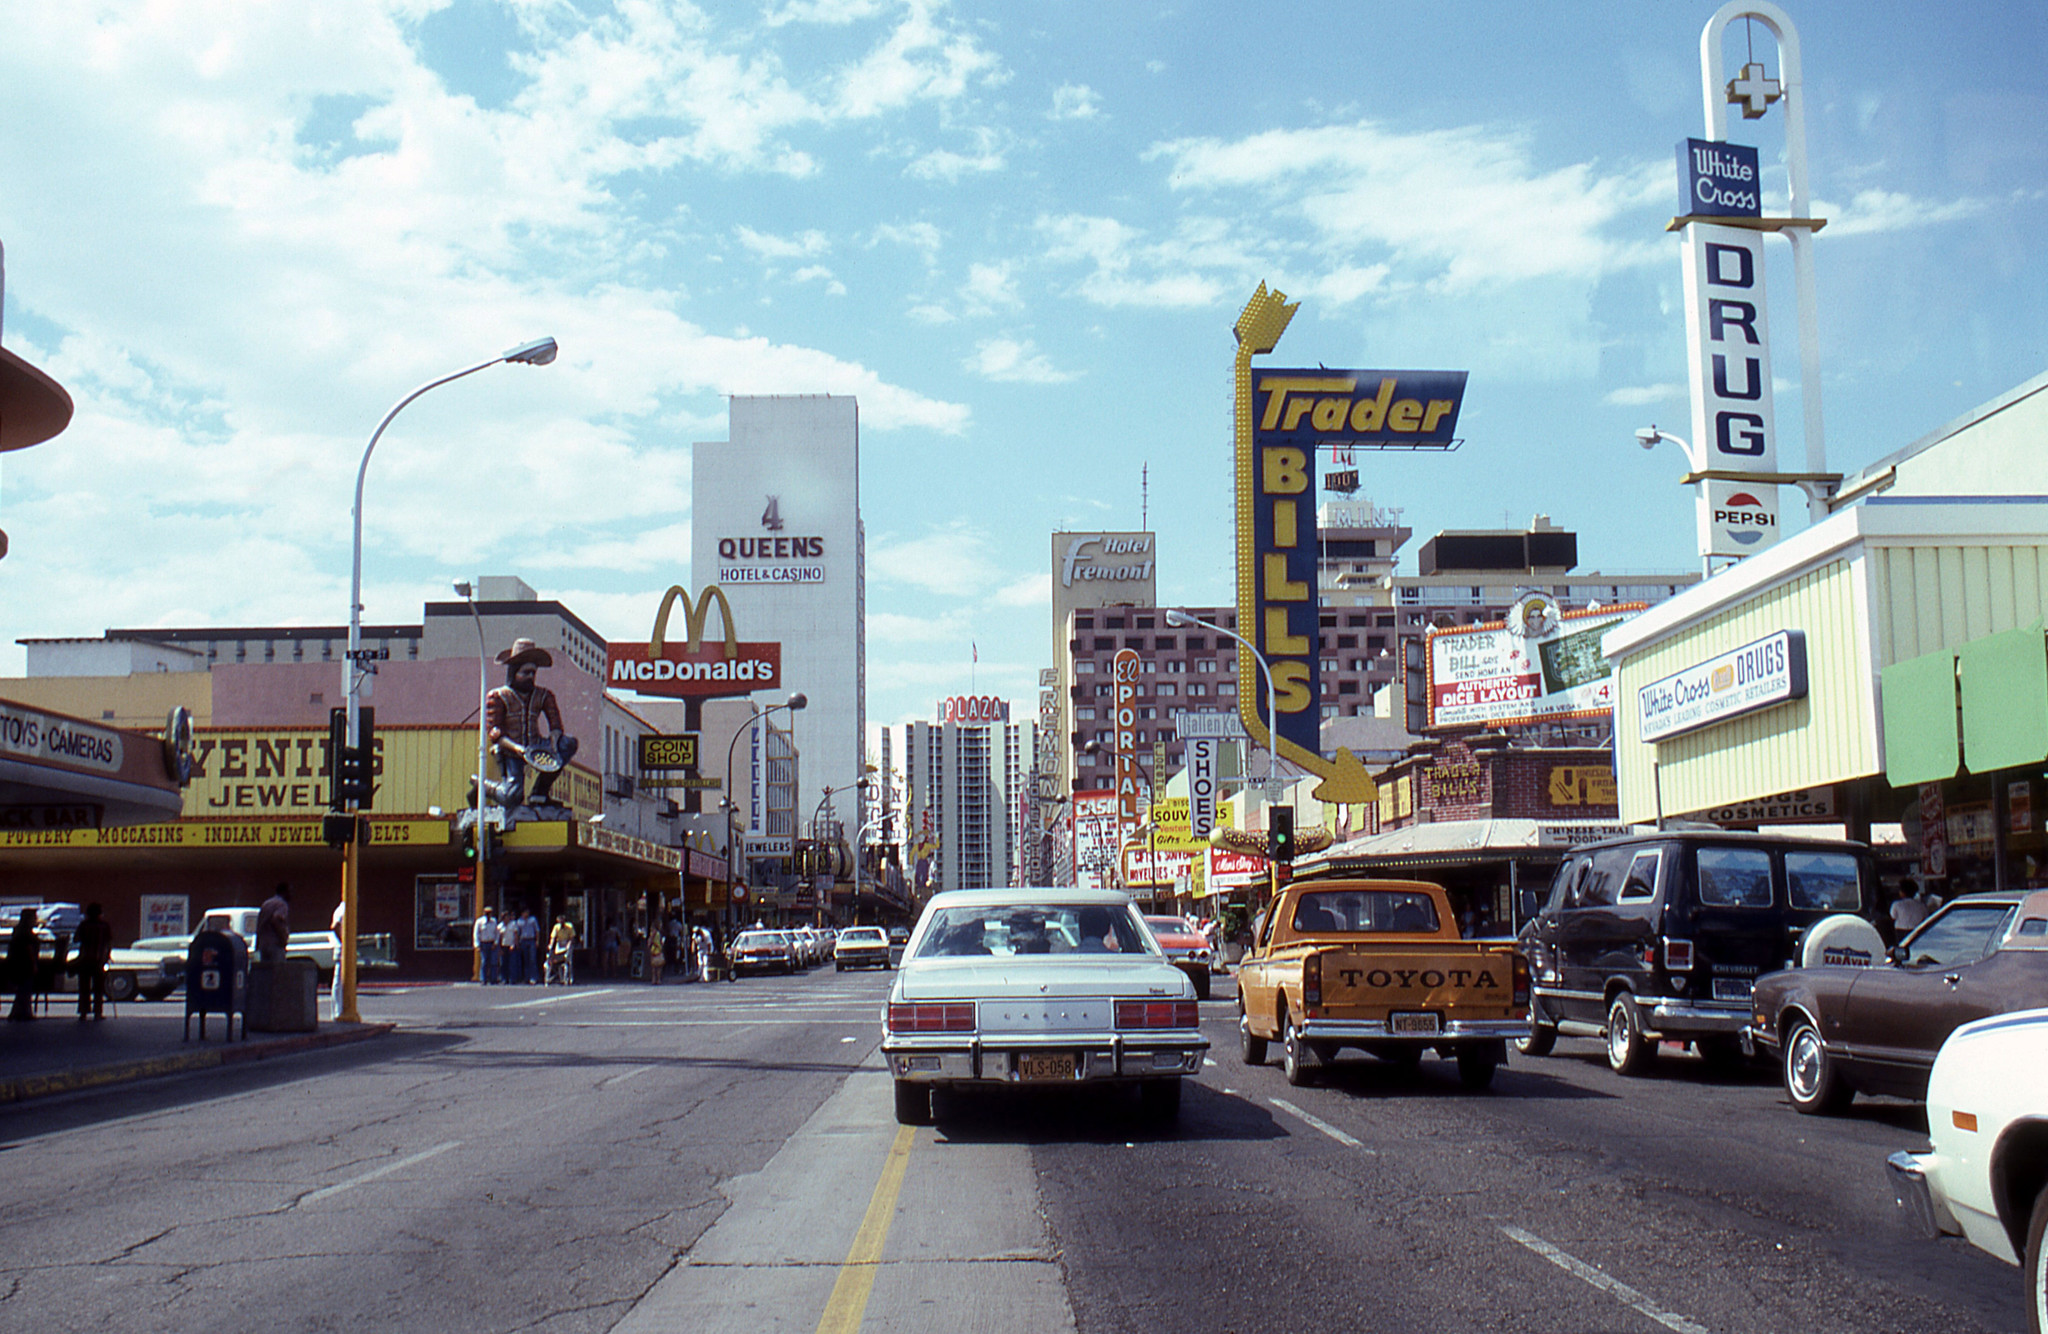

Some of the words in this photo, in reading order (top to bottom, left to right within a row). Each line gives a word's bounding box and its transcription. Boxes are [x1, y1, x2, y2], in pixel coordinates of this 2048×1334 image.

[1693, 148, 1753, 181] White
[1696, 177, 1756, 211] Cross
[1705, 242, 1765, 457] DRUG
[1258, 377, 1453, 432] Trader
[762, 495, 783, 530] 4
[1335, 507, 1404, 528] MINT
[1714, 510, 1775, 527] PEPSI
[719, 537, 823, 559] QUEENS
[1105, 538, 1150, 554] Hotel
[1062, 536, 1153, 588] Fremont
[1262, 446, 1312, 713] BILLS
[1442, 634, 1495, 654] TRADER
[612, 659, 773, 680] McDonald's
[1117, 659, 1138, 683] El
[1450, 656, 1480, 672] BILL
[1737, 640, 1784, 686] DRUGS
[1456, 671, 1475, 679] SEND
[1457, 677, 1518, 692] AUTHENTIC
[1442, 691, 1475, 706] DICE
[1480, 684, 1538, 702] LAYOUT
[1642, 687, 1674, 719] White
[1675, 676, 1710, 706] Cross
[1705, 691, 1741, 713] COSMETIC
[1745, 676, 1787, 701] RETAILERS
[946, 698, 1001, 720] PLAZA
[1183, 714, 1220, 736] Gallen
[0, 715, 38, 747] TOYS
[49, 726, 112, 764] CAMERAS
[650, 741, 689, 752] COIN
[1040, 668, 1059, 818] FREMONT
[647, 752, 691, 763] SHOP
[1118, 685, 1136, 818] PORTAL
[1424, 763, 1480, 780] TRADER
[1194, 741, 1211, 834] SHOES
[1432, 779, 1477, 797] BILL'S
[44, 808, 88, 826] BAR
[1708, 802, 1827, 821] COSMETICS
[6, 829, 72, 844] POTTERY
[97, 827, 184, 843] MOCCASINS
[205, 827, 261, 842] INDIAN
[373, 825, 409, 841] ELTS
[1546, 826, 1629, 835] CHINESE-THAI
[745, 842, 790, 853] JEWELERS
[1129, 866, 1167, 881] NOVELIES
[1340, 969, 1498, 988] TOYOTA
[1023, 1060, 1071, 1074] VLS-058
